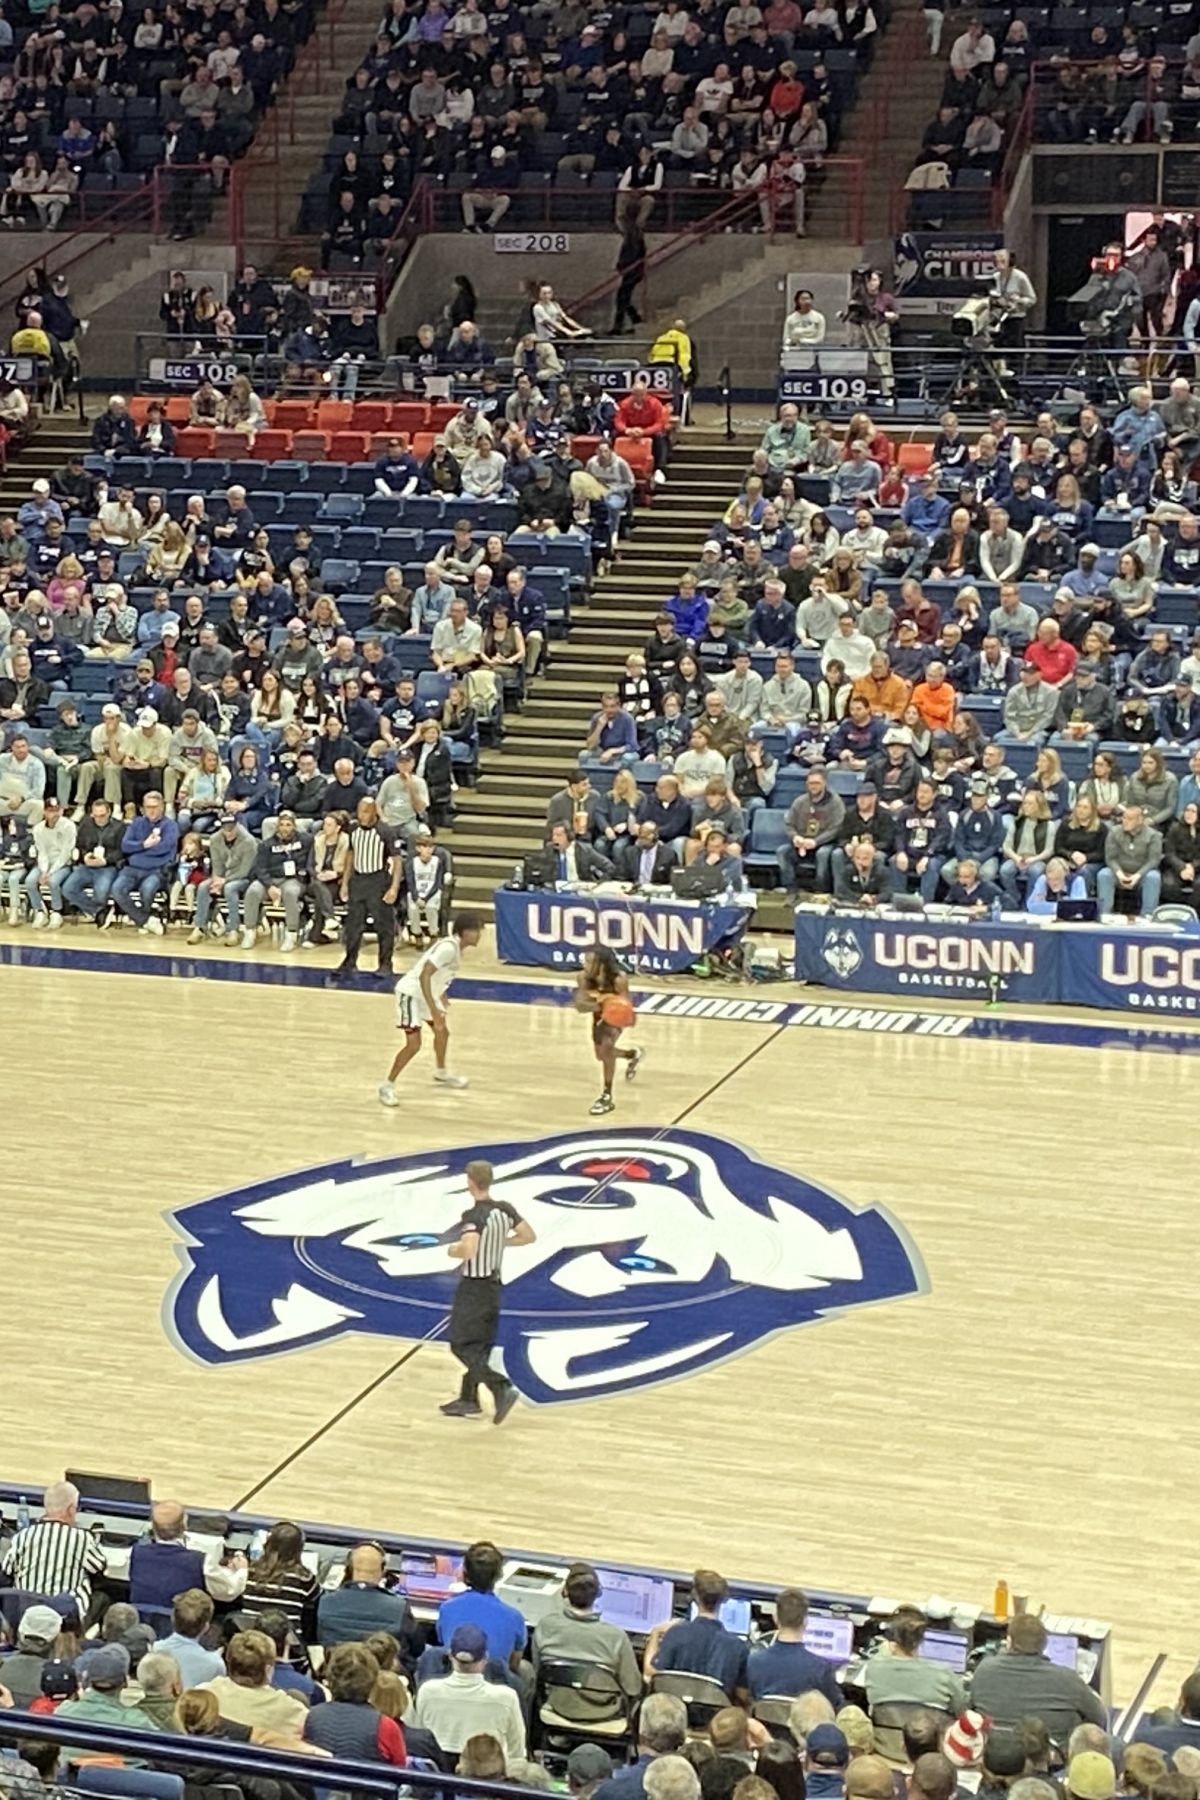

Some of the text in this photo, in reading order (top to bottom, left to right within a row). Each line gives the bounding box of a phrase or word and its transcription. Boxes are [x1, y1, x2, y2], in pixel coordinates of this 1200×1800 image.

[498, 235, 568, 252] SEC 208
[166, 365, 191, 377] SEC
[590, 370, 668, 389] SEC 108
[783, 378, 867, 398] SEC 109
[527, 903, 703, 954] UCONN
[873, 931, 1035, 975] UCONN
[898, 972, 1009, 990] BASKETBAL
[633, 993, 975, 1037] ALUMNI COURT
